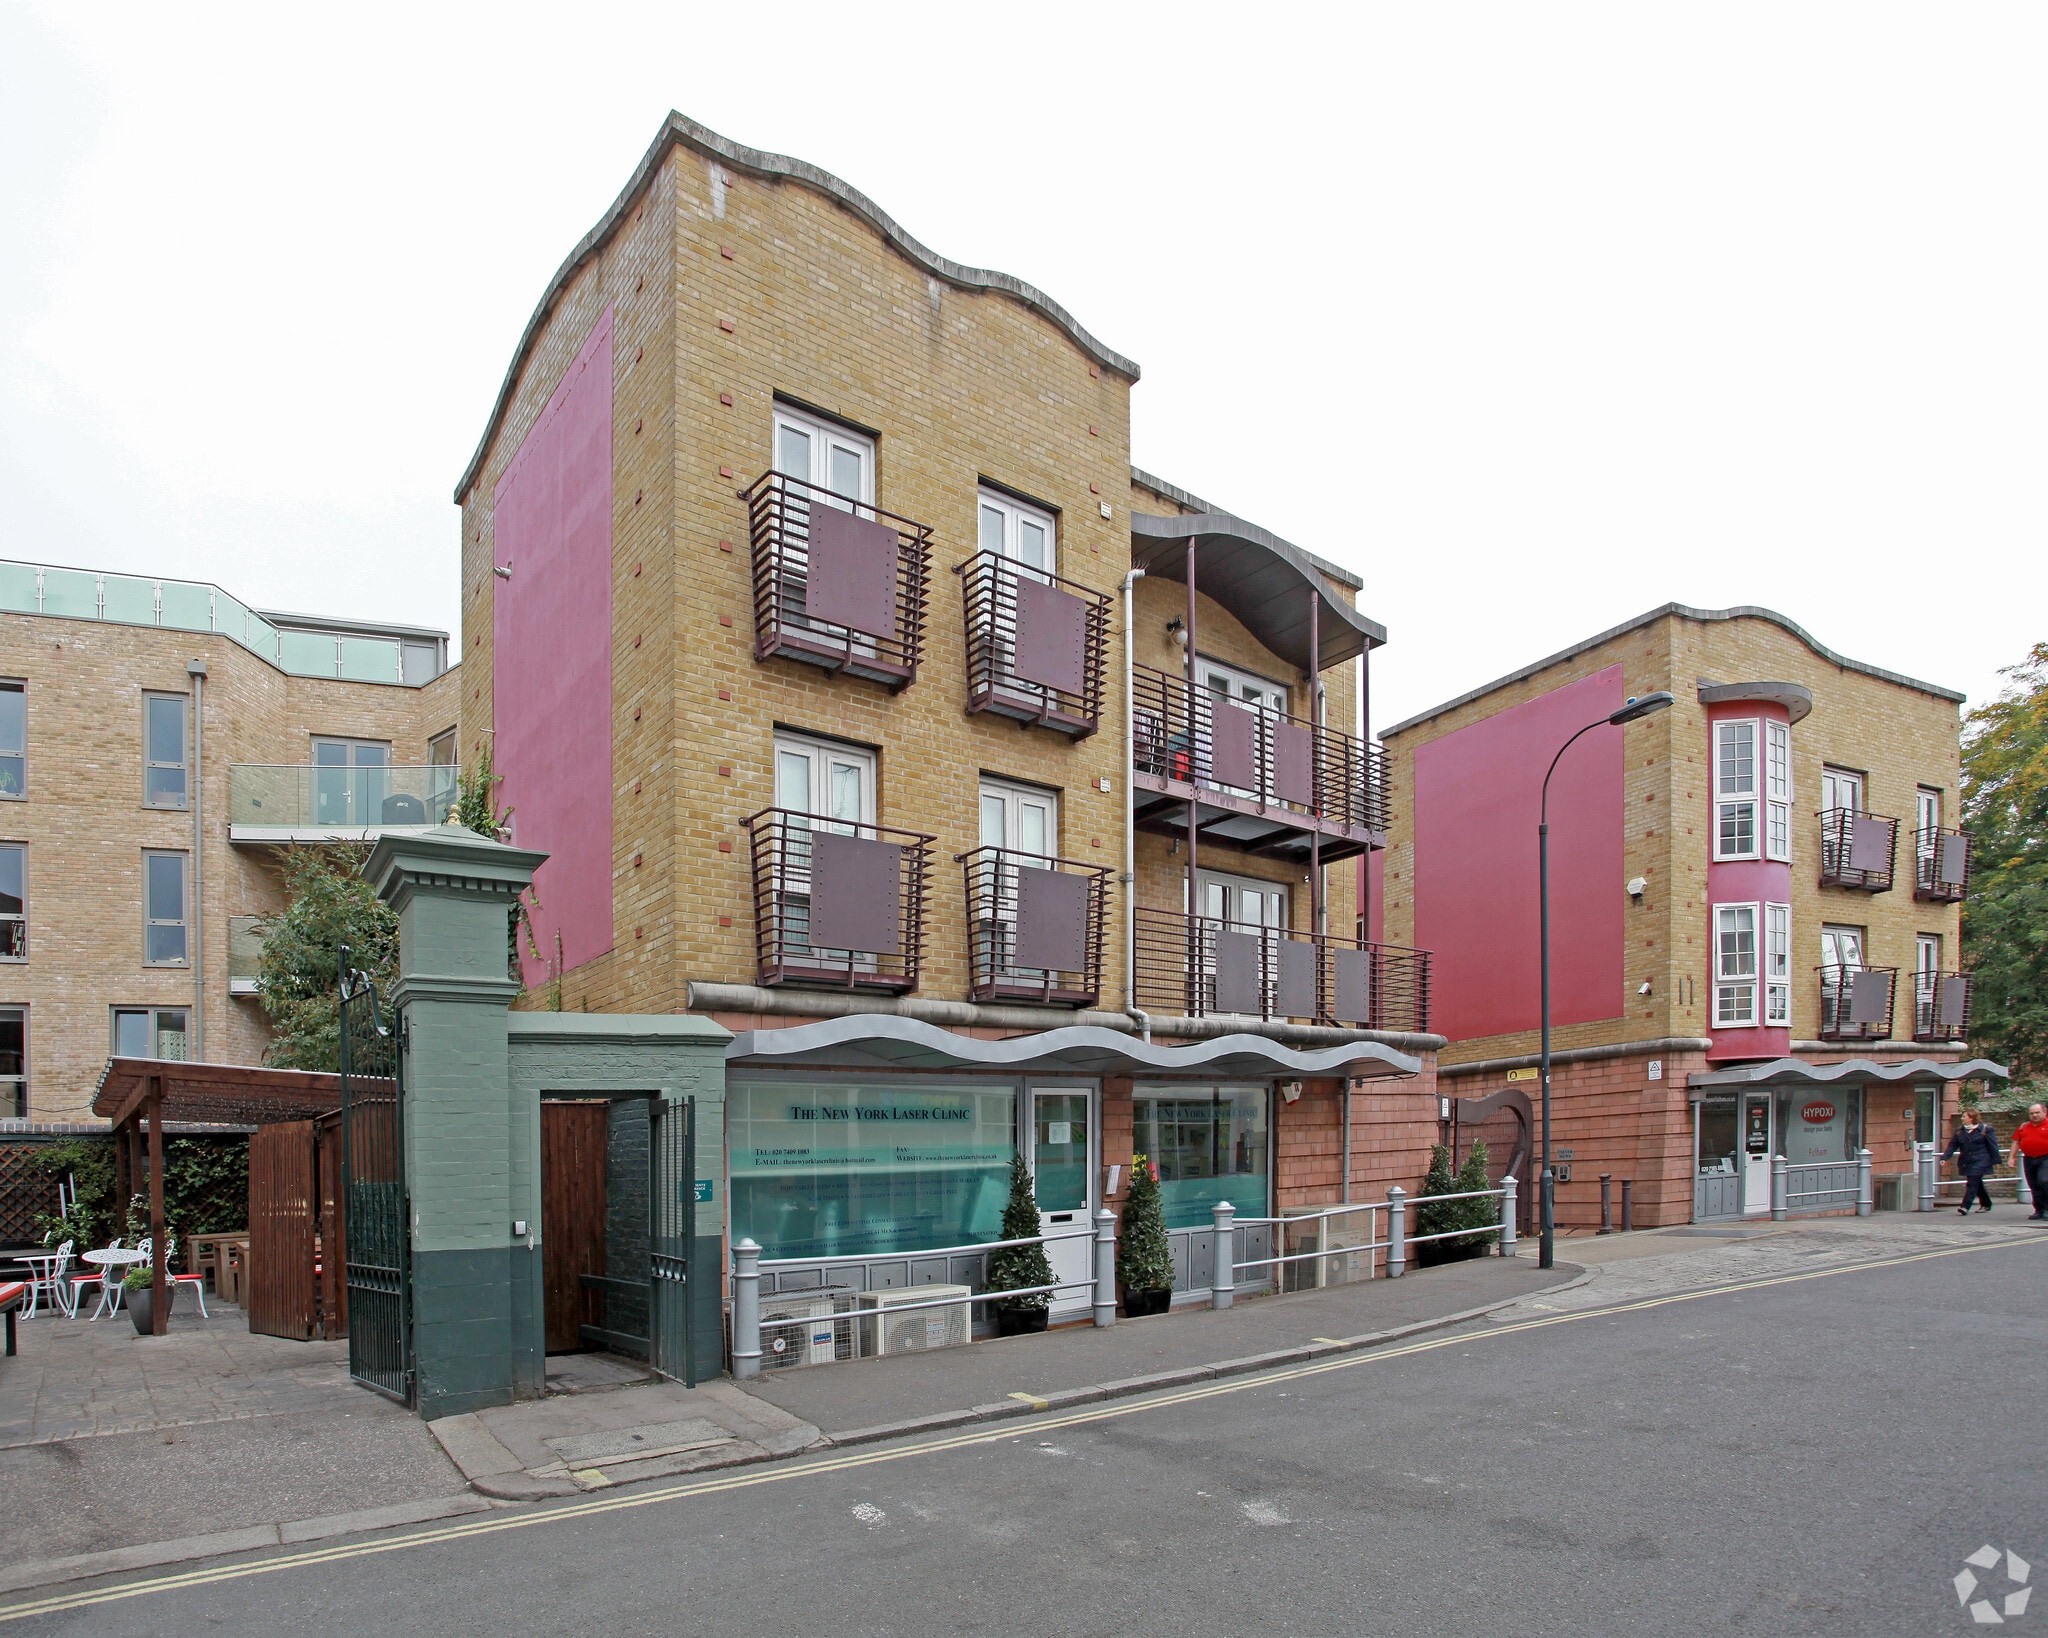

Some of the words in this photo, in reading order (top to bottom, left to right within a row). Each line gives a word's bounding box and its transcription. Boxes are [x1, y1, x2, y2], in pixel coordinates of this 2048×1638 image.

[791, 1106, 818, 1120] THE
[822, 1107, 851, 1120] NEW
[855, 1107, 889, 1120] YORK
[893, 1107, 929, 1120] LASER
[932, 1107, 970, 1120] CLINIC
[1185, 1108, 1206, 1118] YORK
[1803, 1107, 1833, 1118] HYPOXI
[772, 1148, 782, 1156] 020
